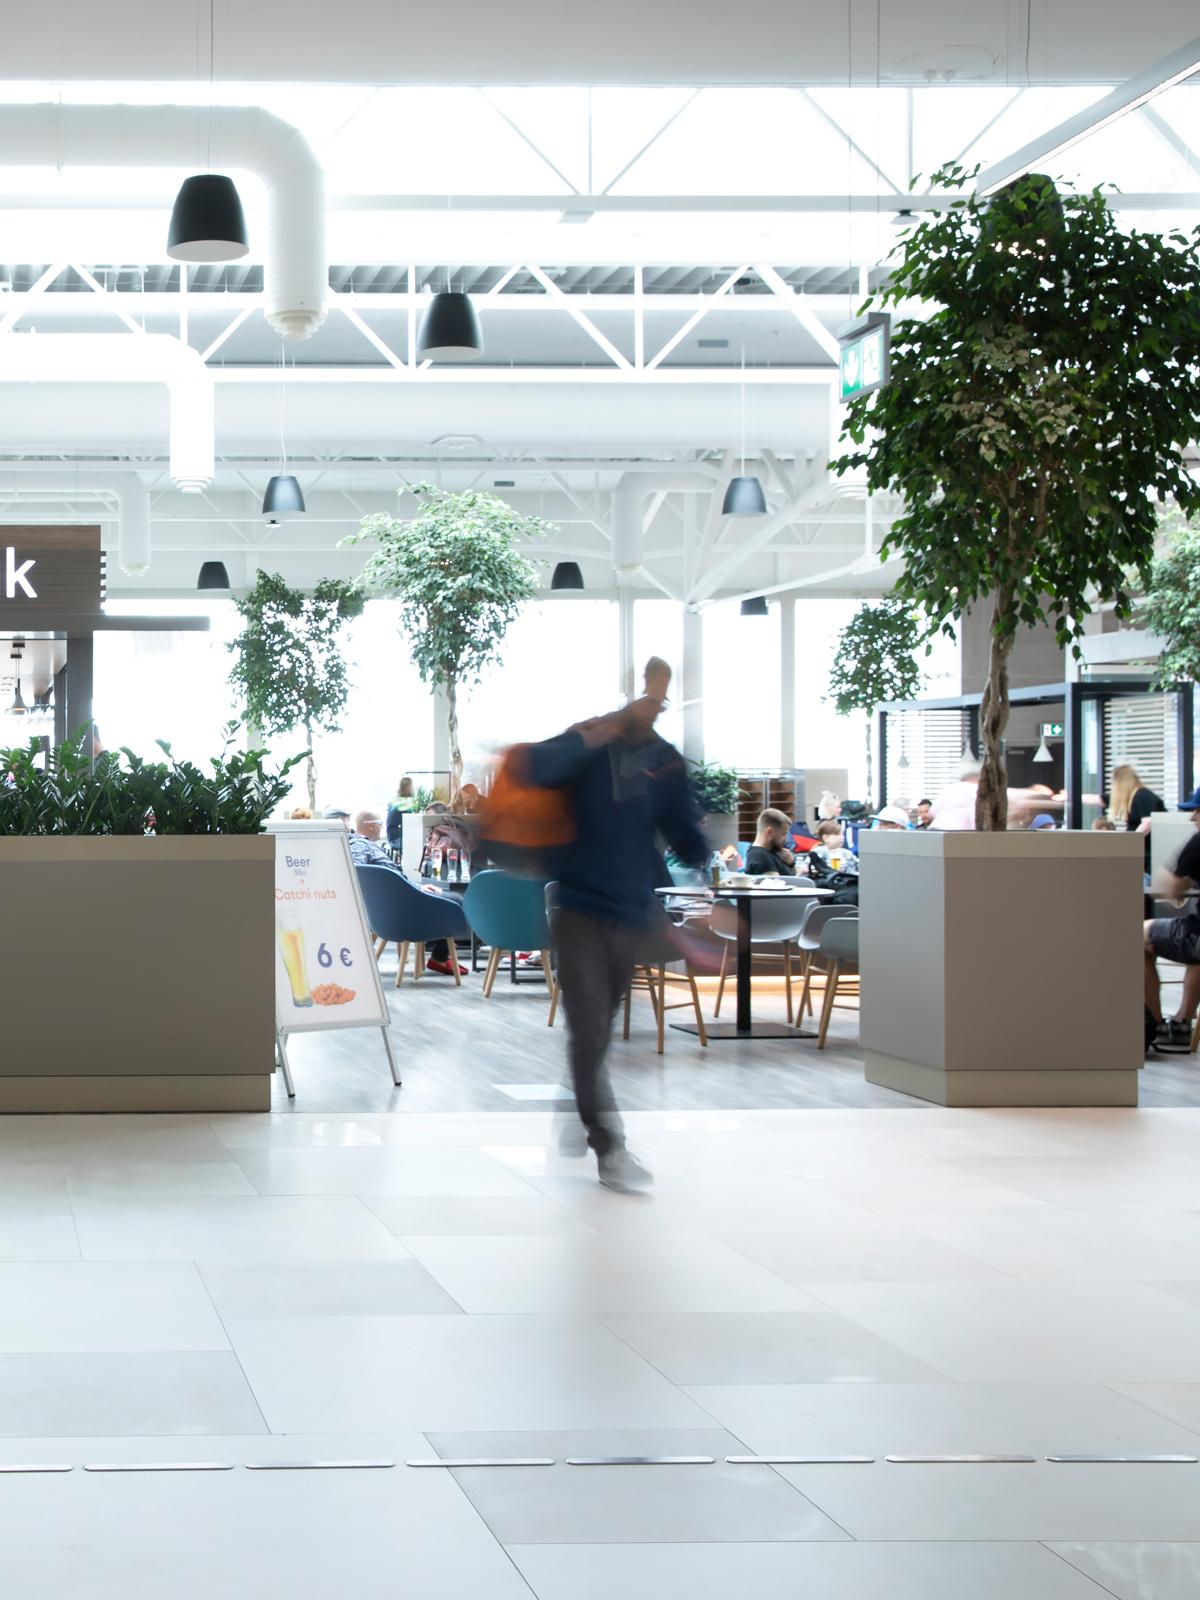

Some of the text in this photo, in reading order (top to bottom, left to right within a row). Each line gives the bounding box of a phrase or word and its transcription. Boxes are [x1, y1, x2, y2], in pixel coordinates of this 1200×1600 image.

[285, 855, 311, 867] Beer
[314, 889, 337, 899] nuts
[317, 943, 353, 968] 6 €
